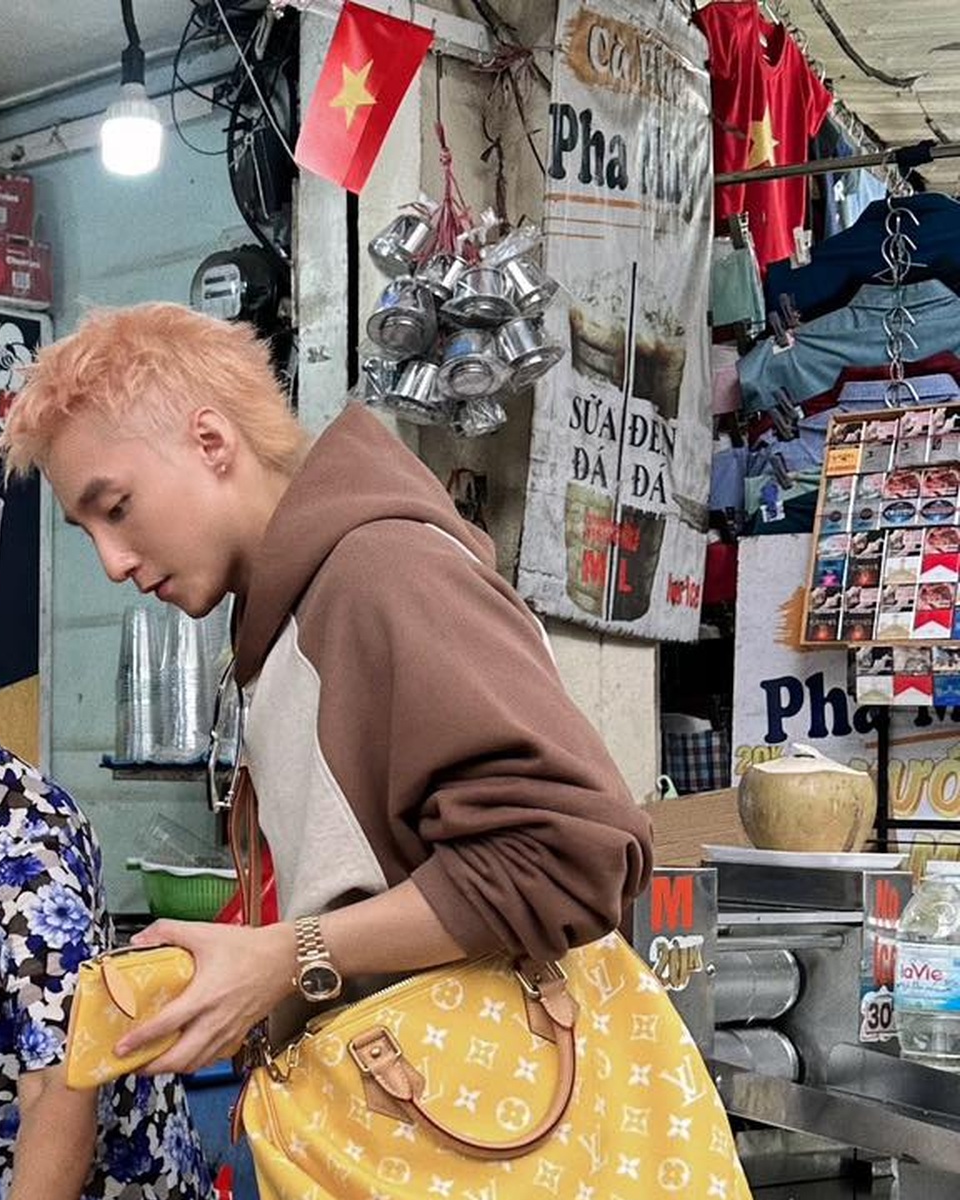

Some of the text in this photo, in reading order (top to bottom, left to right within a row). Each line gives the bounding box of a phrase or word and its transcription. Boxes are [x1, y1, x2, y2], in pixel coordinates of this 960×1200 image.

[549, 103, 628, 192] Pha
[570, 394, 617, 442] SỮA
[628, 413, 677, 457] ĐEN
[572, 445, 608, 488] ĐÁ
[632, 462, 667, 503] ĐÁ
